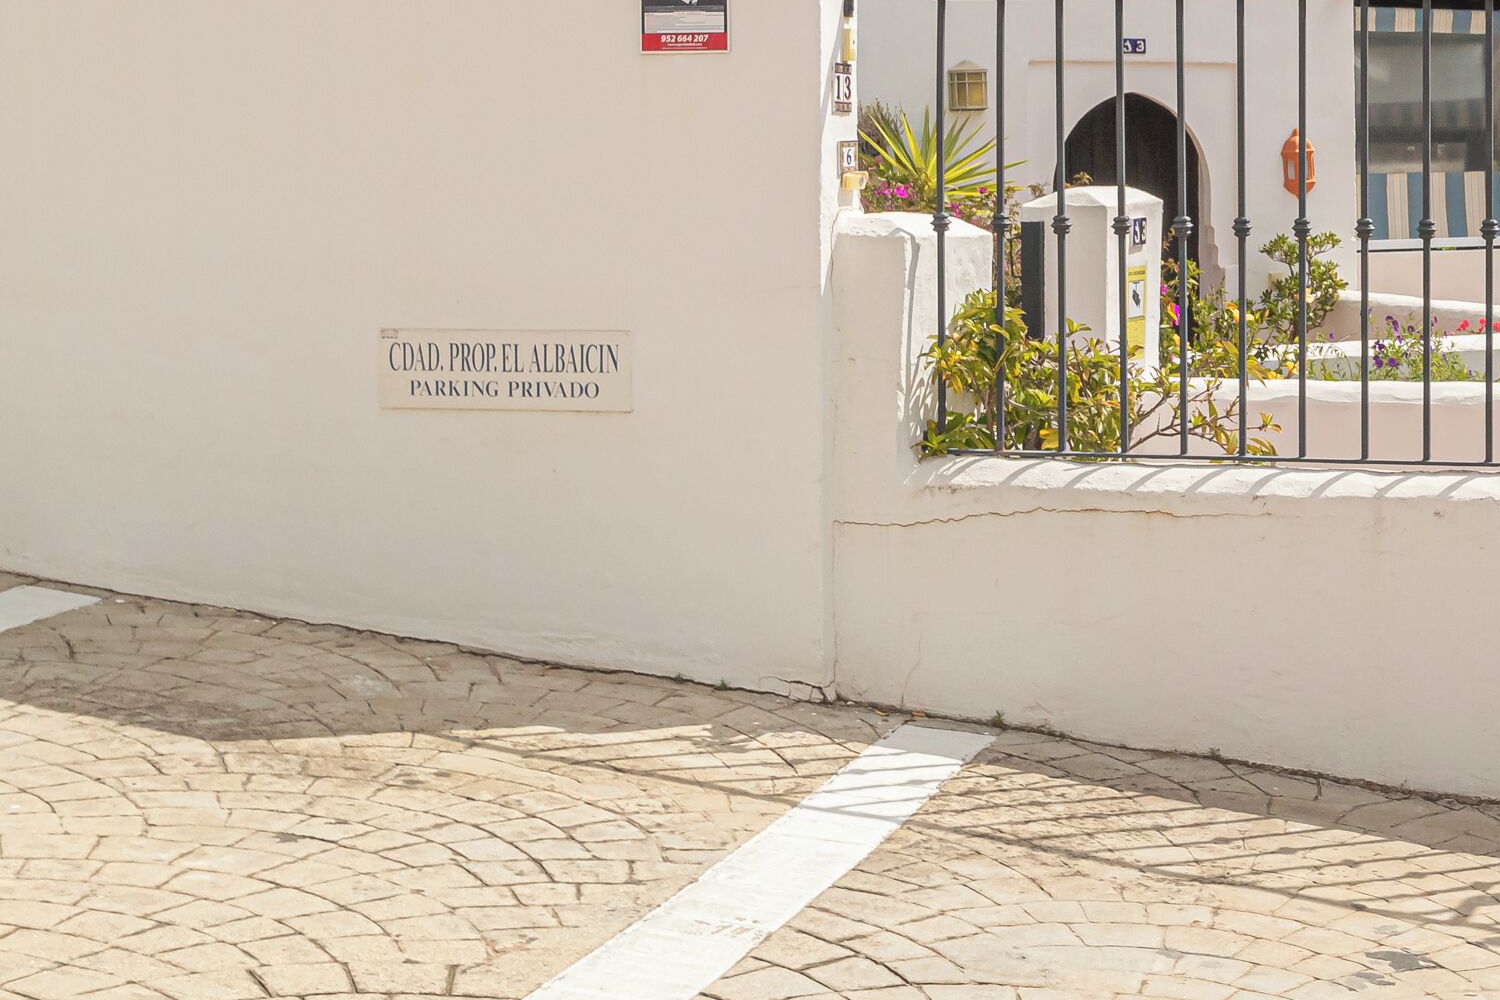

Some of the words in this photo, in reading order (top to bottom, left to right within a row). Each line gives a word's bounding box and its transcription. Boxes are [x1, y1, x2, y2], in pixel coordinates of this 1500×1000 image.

[661, 35, 676, 43] 952
[677, 35, 692, 43] 664
[694, 34, 709, 42] 207
[836, 75, 852, 101] 13
[846, 149, 852, 165] 6
[389, 342, 444, 372] CDAD.
[450, 343, 497, 373] PROP.
[502, 344, 524, 373] EL
[529, 344, 619, 374] ALBAICIN
[410, 380, 499, 398] PARKING
[508, 381, 600, 399] PRIVADO
